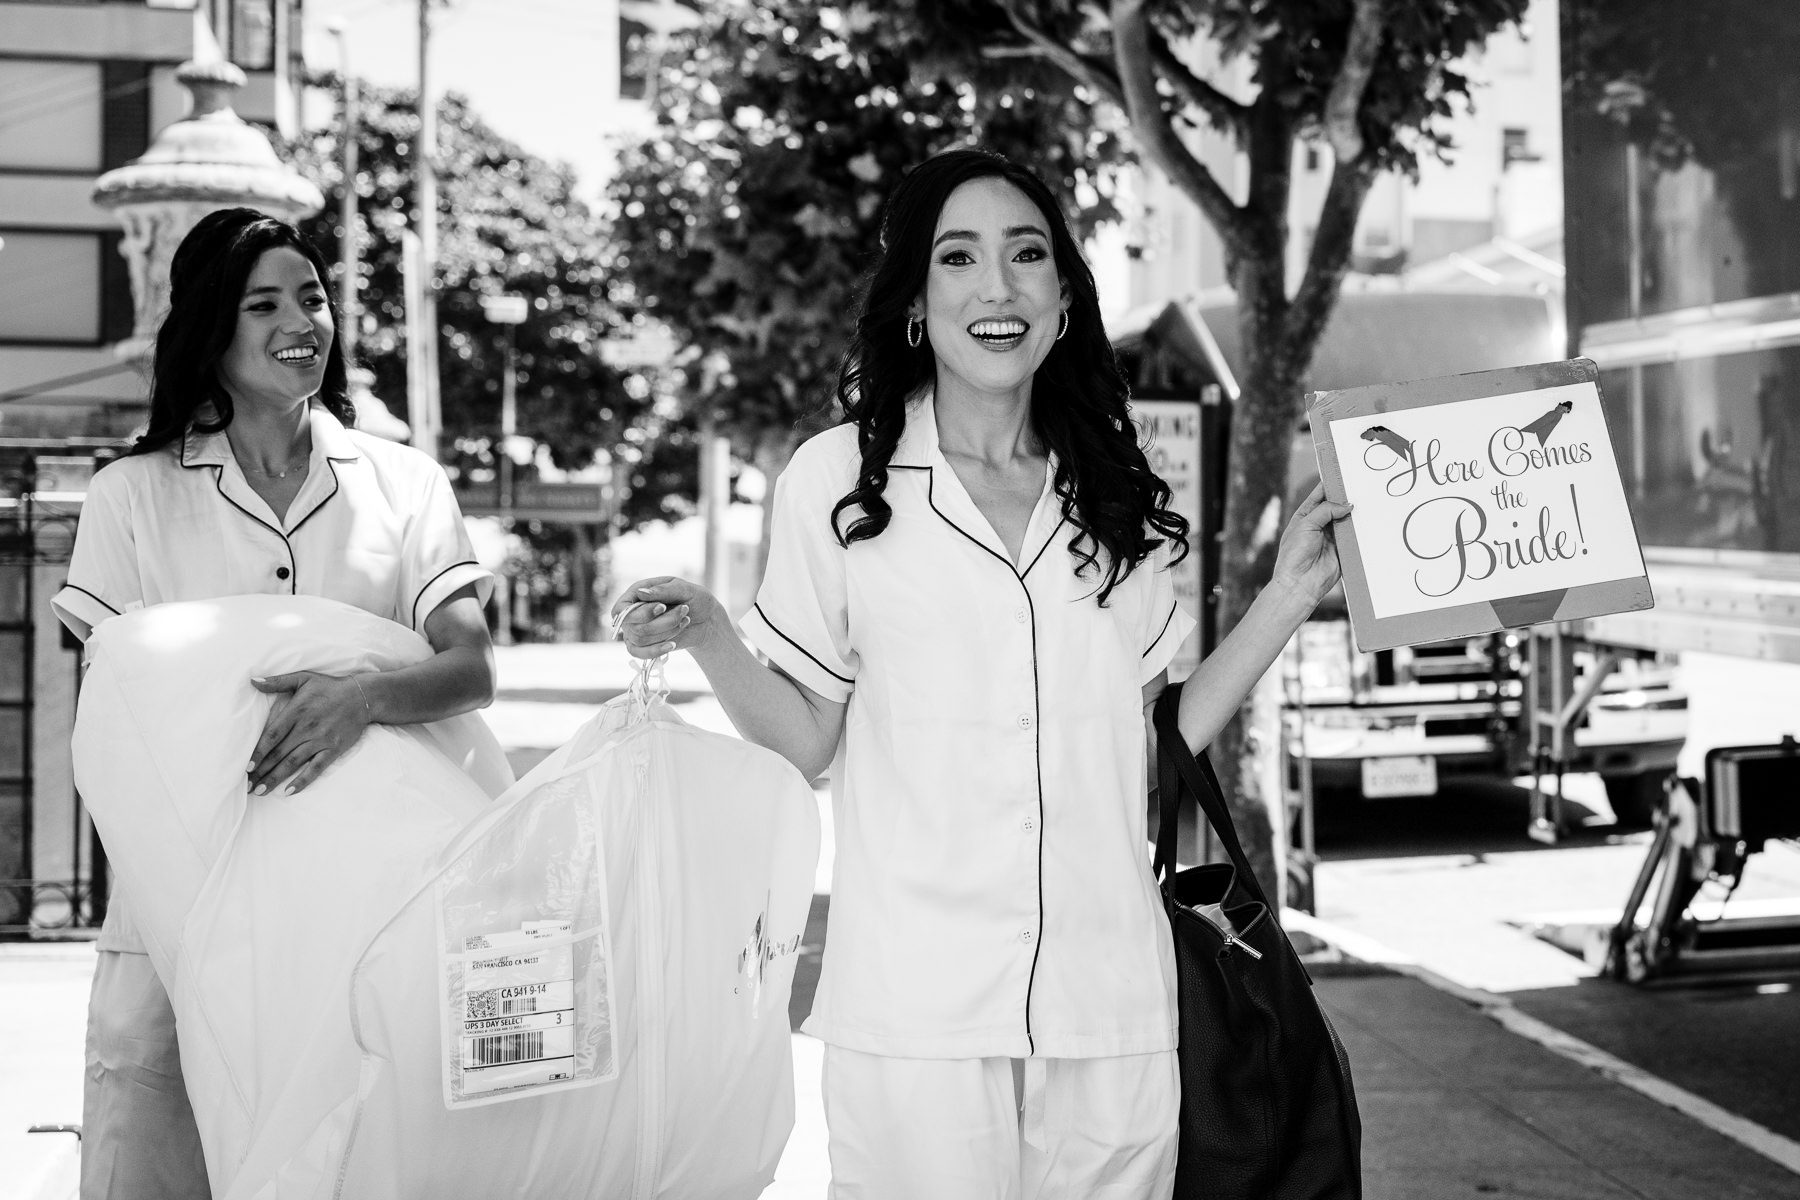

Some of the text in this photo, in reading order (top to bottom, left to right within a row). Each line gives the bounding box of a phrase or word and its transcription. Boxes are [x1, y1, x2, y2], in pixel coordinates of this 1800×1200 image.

[1363, 426, 1592, 497] Here Comes
[1490, 480, 1528, 511] the
[1402, 483, 1589, 597] Bride!
[501, 988, 512, 999] CA
[530, 984, 546, 995] 9-14
[464, 1021, 478, 1030] UPS
[486, 1020, 500, 1028] DAY
[500, 1017, 523, 1027] SELECT
[556, 1013, 562, 1025] 3
